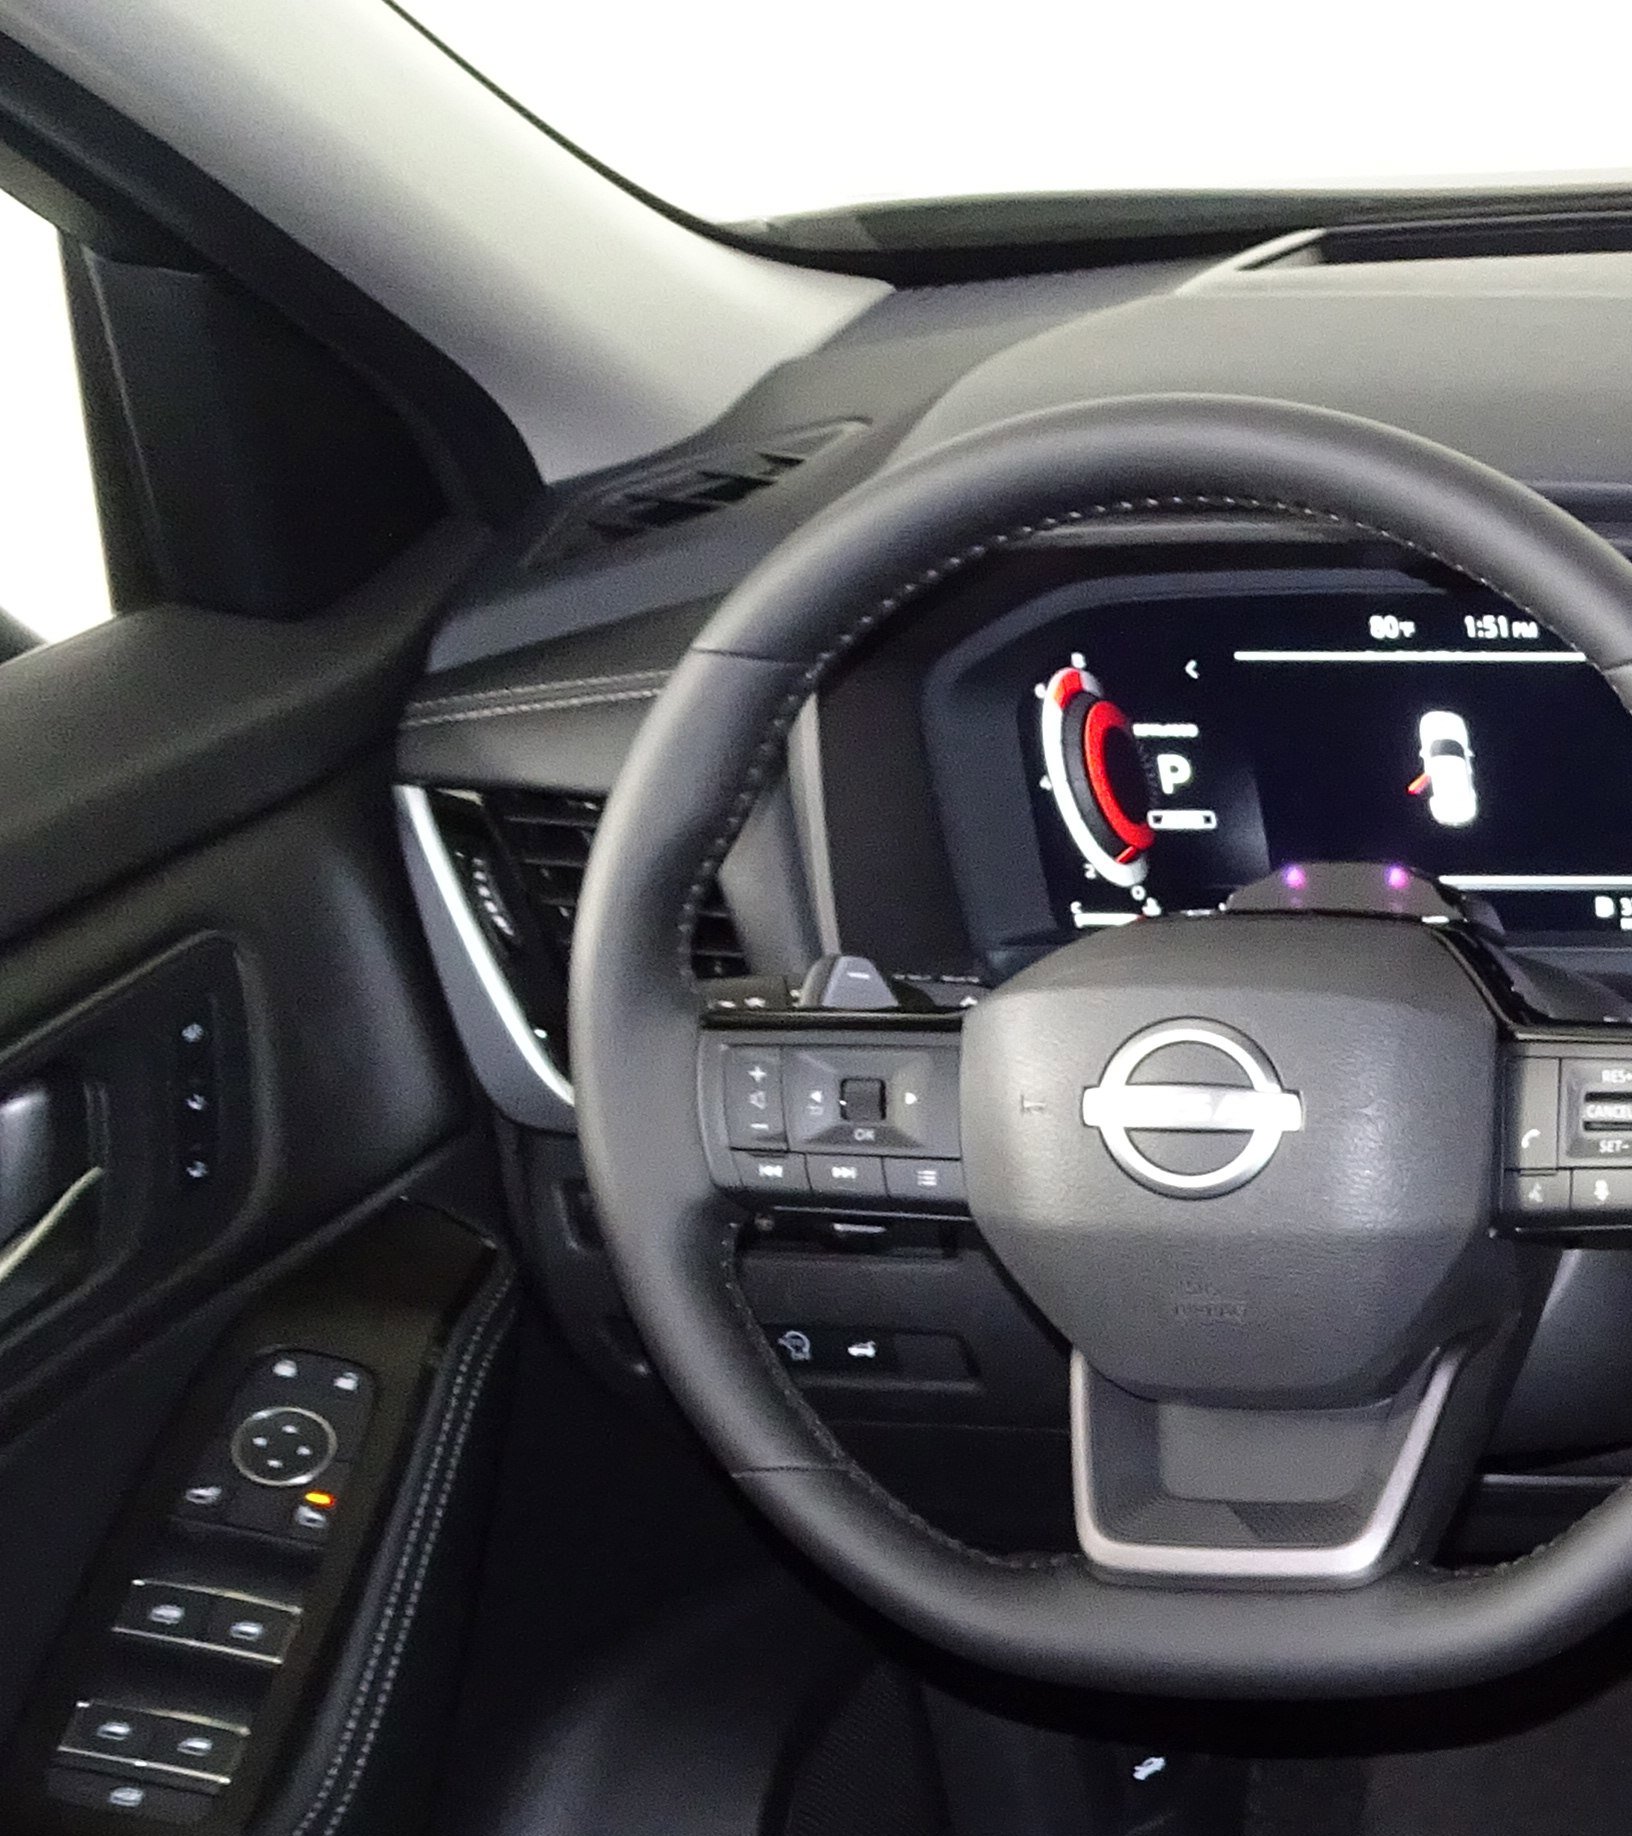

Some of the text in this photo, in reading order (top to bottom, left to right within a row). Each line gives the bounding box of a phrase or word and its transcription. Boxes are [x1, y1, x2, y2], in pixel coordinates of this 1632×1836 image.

[1464, 615, 1509, 638] 1:51
[1157, 753, 1191, 794] P
[854, 1128, 875, 1141] OK
